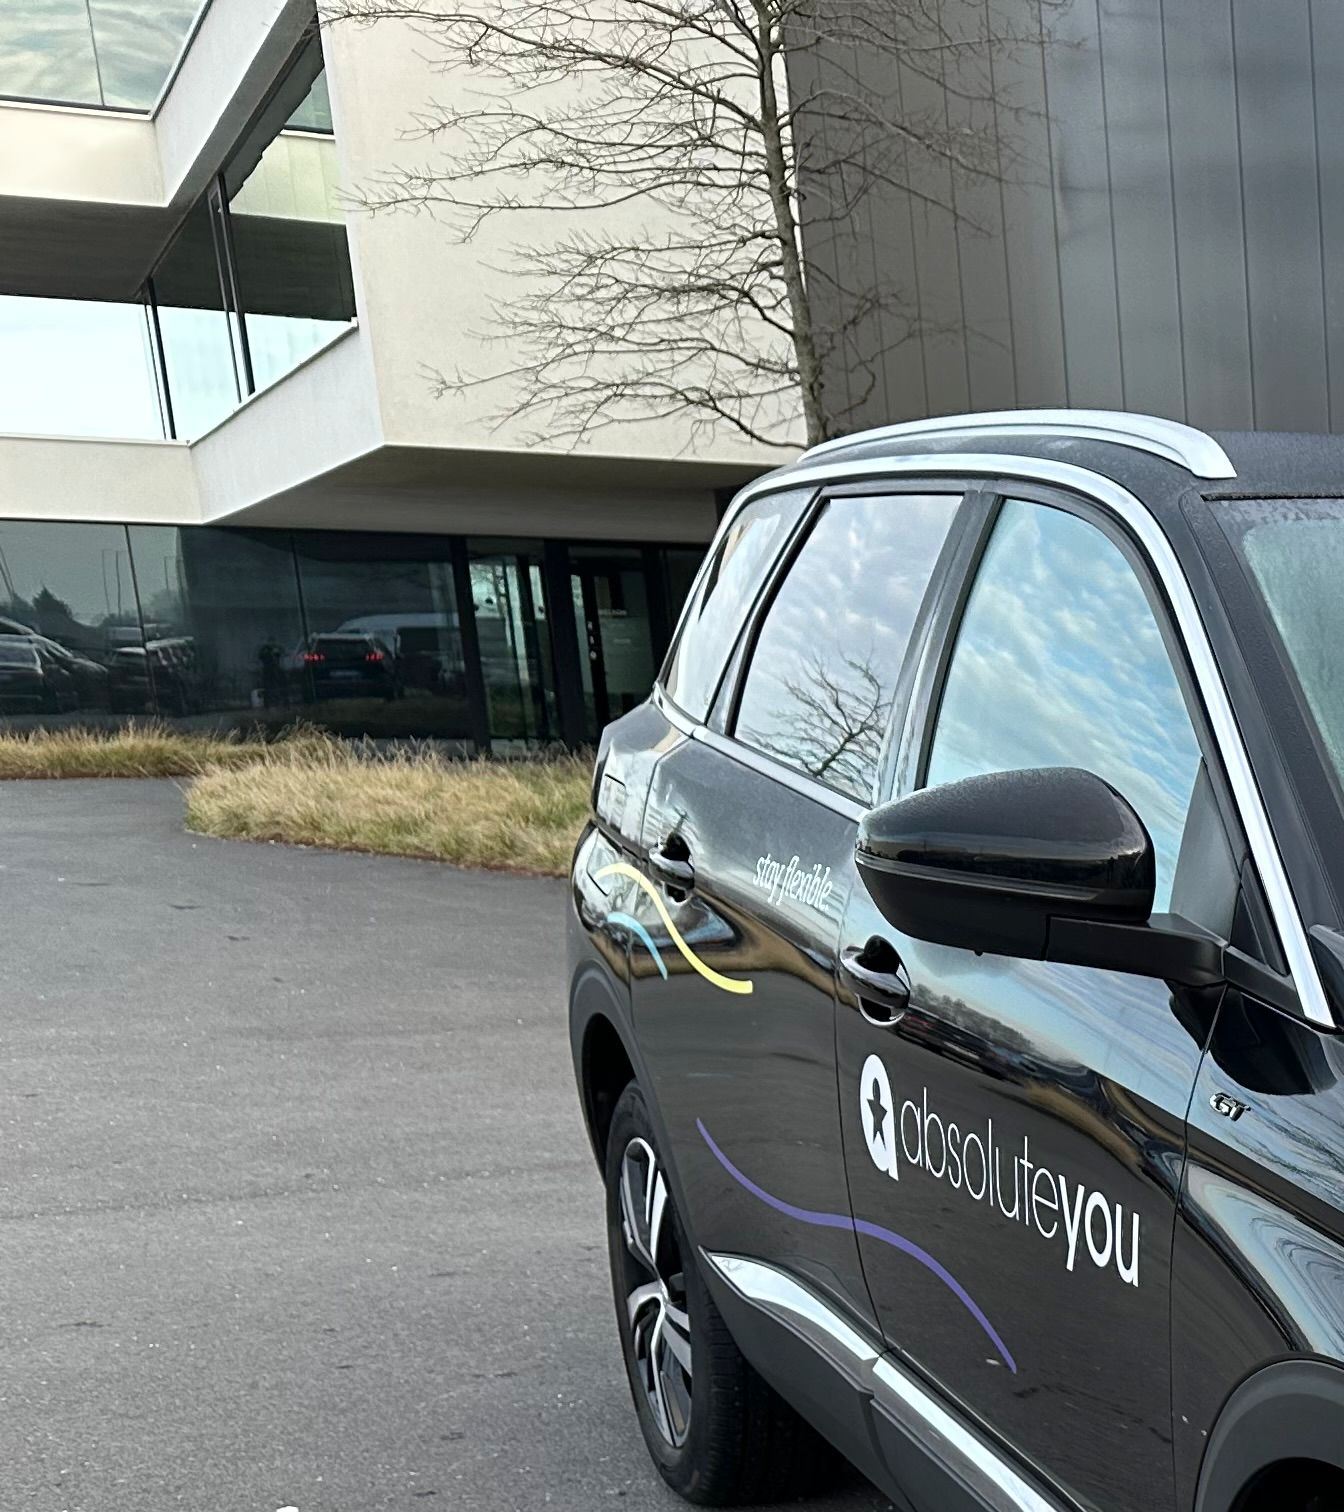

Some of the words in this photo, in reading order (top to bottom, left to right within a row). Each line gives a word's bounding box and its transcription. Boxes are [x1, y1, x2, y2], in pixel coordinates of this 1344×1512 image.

[753, 852, 786, 904] stay
[1209, 1092, 1251, 1121] GT
[900, 1086, 1140, 1287] absoluteyou
